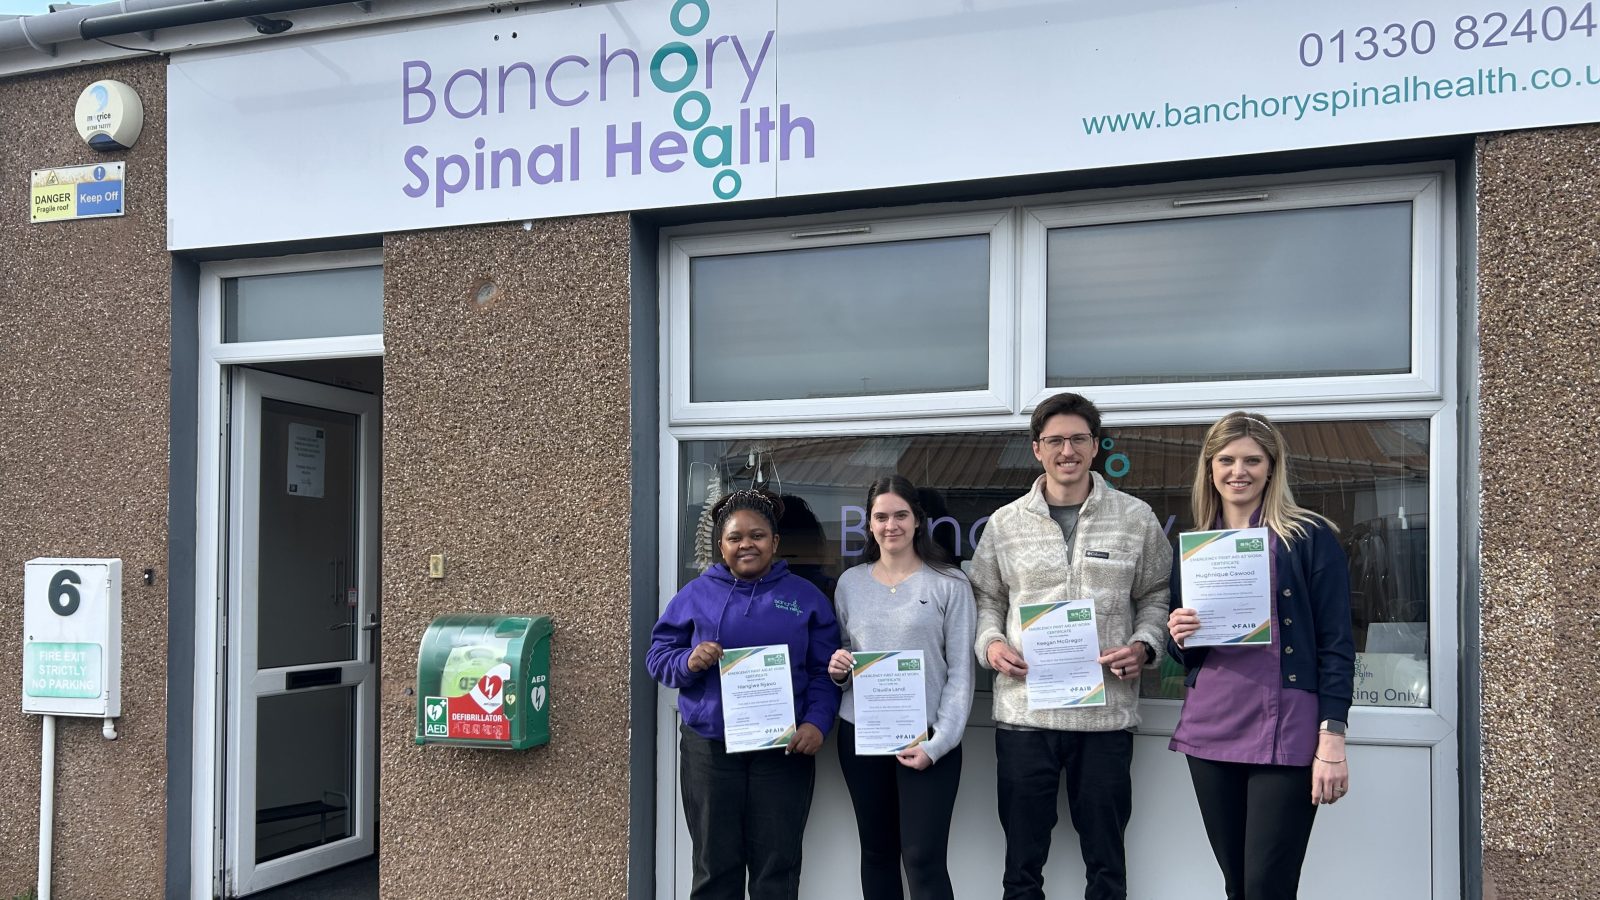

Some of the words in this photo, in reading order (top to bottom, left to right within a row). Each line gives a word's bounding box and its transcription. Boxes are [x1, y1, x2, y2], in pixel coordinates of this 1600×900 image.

[1299, 20, 1436, 67] 01330
[1453, 2, 1597, 50] 82404
[402, 30, 775, 125] Banchory
[402, 127, 580, 208] Spinal
[606, 103, 815, 178] Health
[35, 192, 71, 205] DANGER
[80, 193, 102, 204] Keep
[104, 191, 119, 201] Off
[36, 204, 56, 213] Fragile
[56, 203, 69, 211] roof
[48, 569, 81, 616] 6
[40, 651, 62, 661] FIRE
[64, 651, 87, 661] EXIT
[38, 665, 88, 676] STRICTLY
[31, 680, 46, 689] NO
[48, 680, 95, 690] PARKING
[531, 675, 546, 684] AED
[1384, 688, 1420, 704] Only
[451, 713, 503, 722] DEFIBRILLATOR
[426, 724, 447, 733] AED
